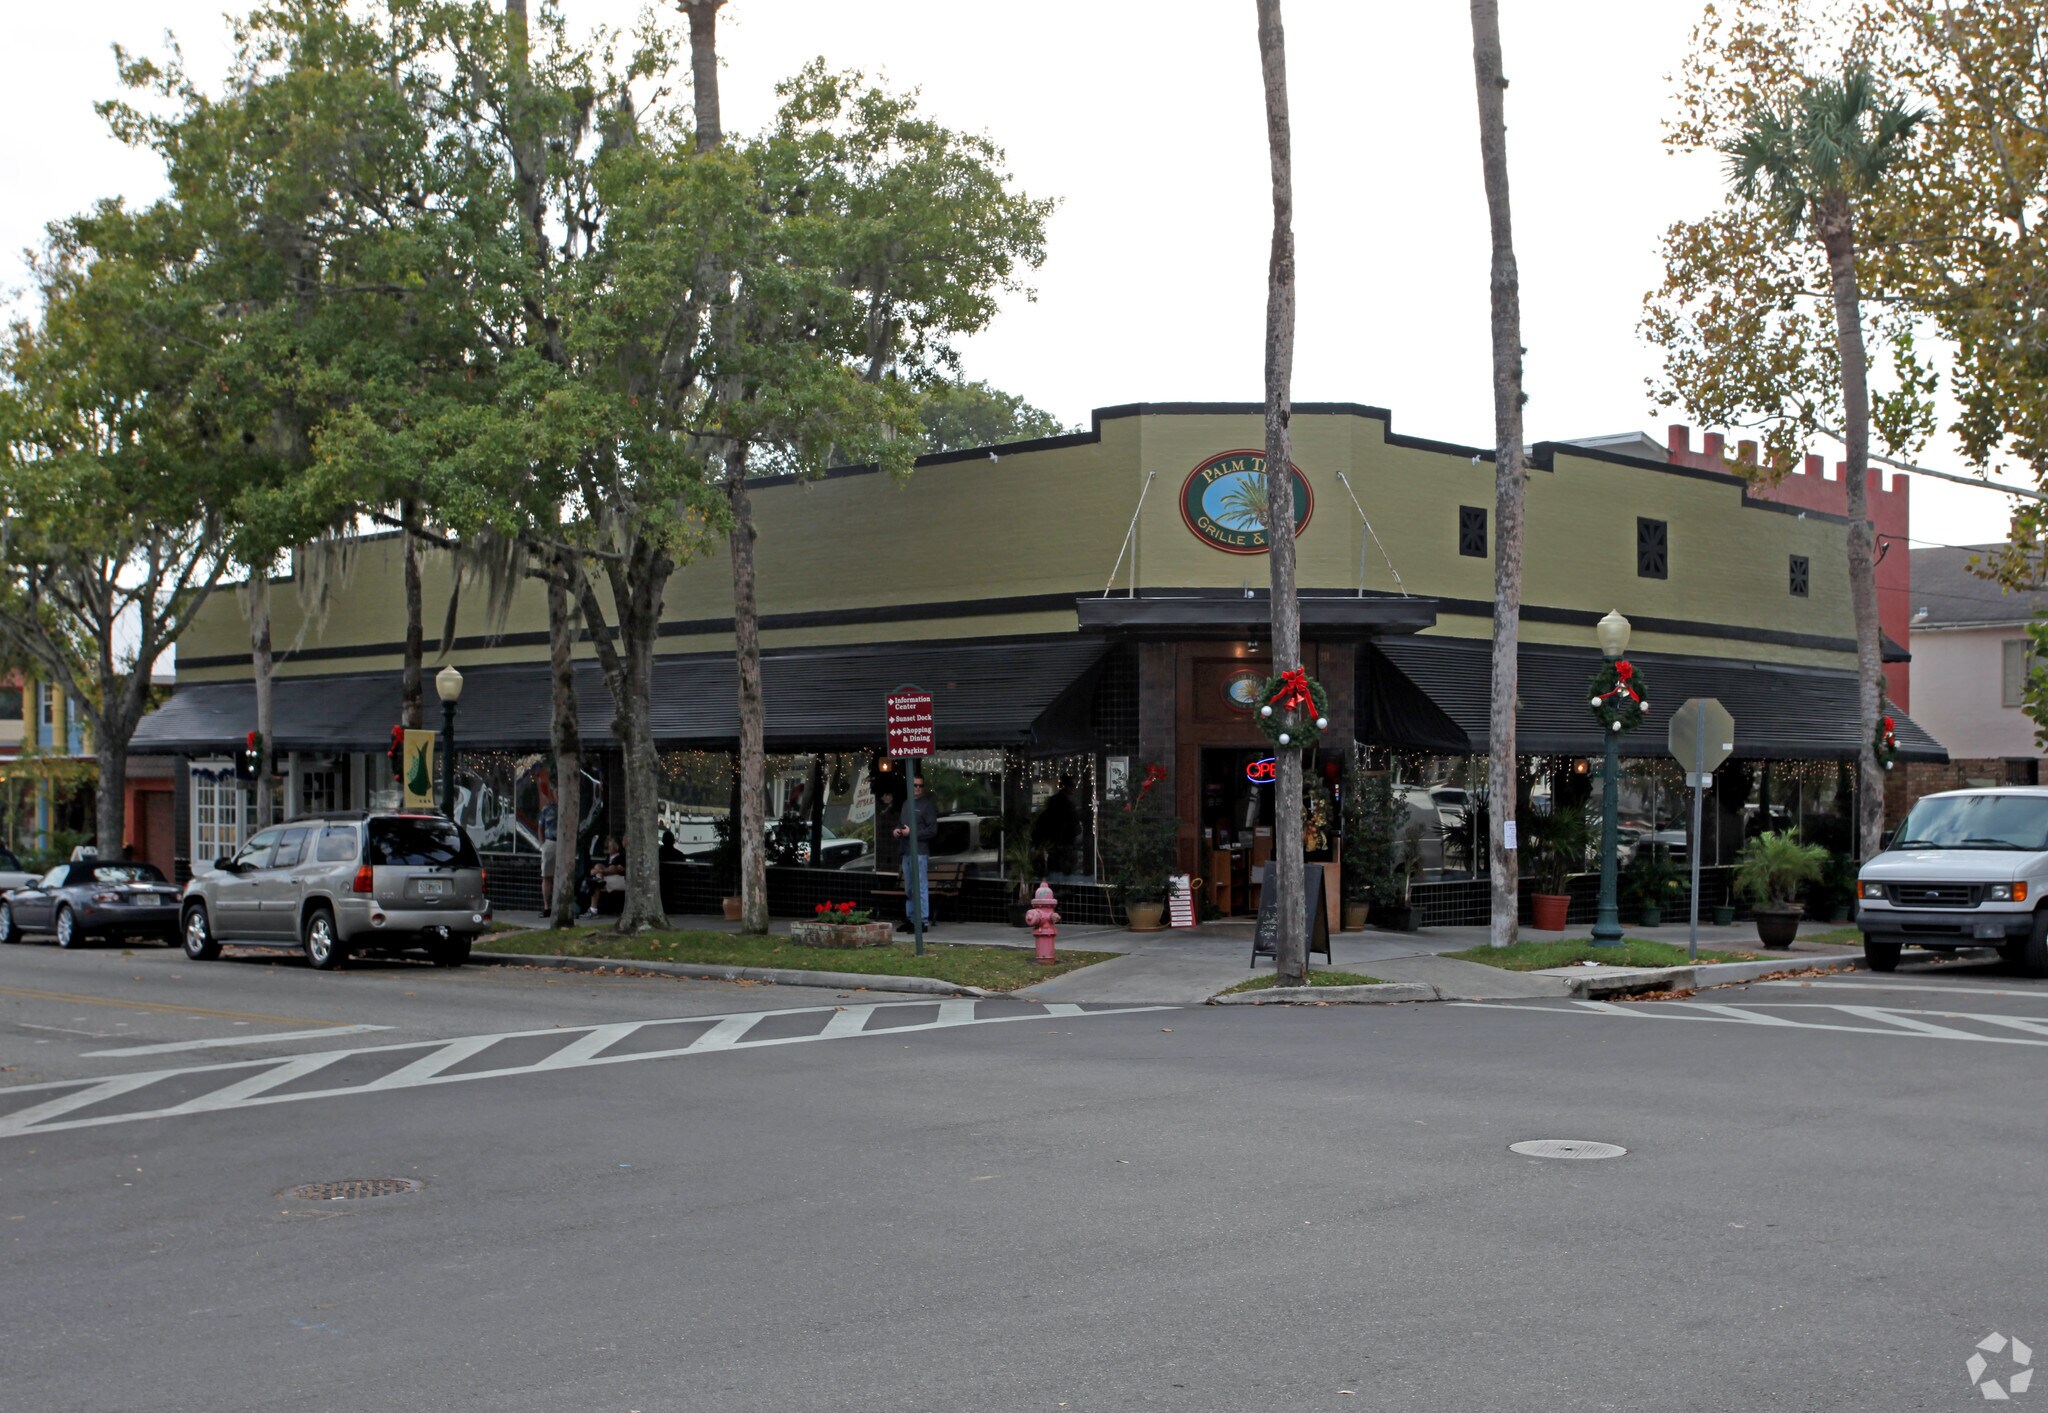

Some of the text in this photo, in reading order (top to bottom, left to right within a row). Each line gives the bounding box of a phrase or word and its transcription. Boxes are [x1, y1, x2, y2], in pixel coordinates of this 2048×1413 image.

[1202, 459, 1245, 484] PALM
[1197, 516, 1265, 545] GRILLE &
[895, 696, 931, 704] Information
[902, 726, 932, 735] Shopping
[909, 735, 931, 743] Dining
[903, 747, 928, 755] Parking
[1246, 762, 1276, 778] OPE
